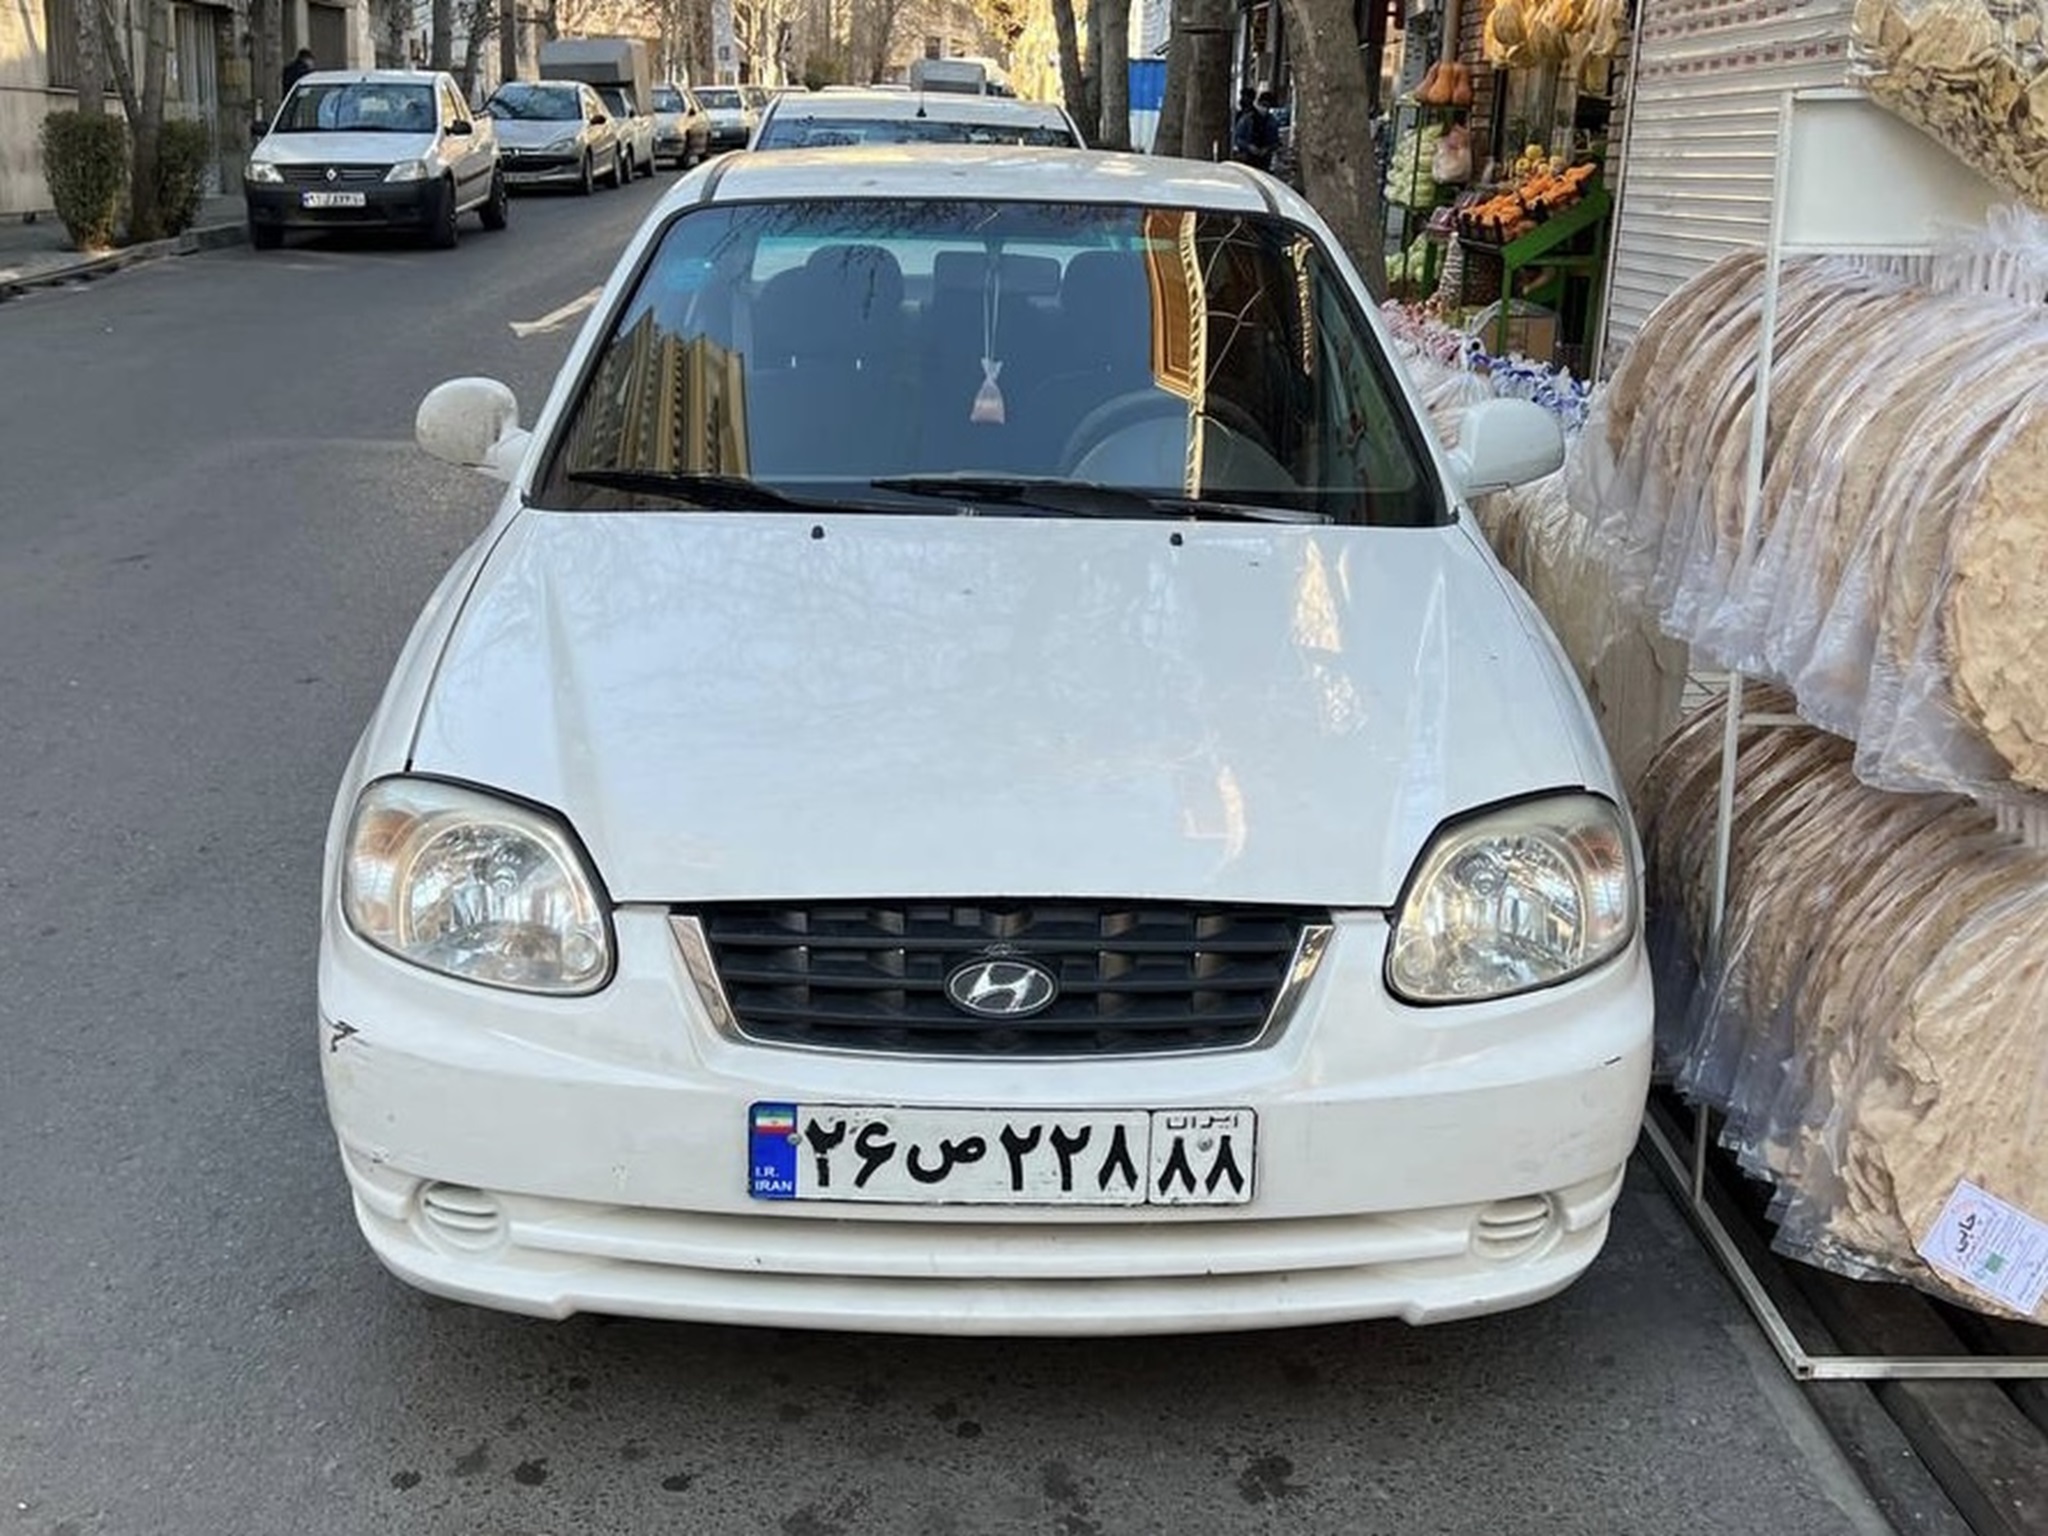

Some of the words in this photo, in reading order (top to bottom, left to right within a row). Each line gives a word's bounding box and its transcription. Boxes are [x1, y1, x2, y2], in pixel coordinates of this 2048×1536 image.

[1166, 1115, 1239, 1130] ایران
[1157, 1134, 1245, 1196] ۸۸
[754, 1166, 779, 1178] I.R.
[754, 1180, 793, 1192] IRAN
